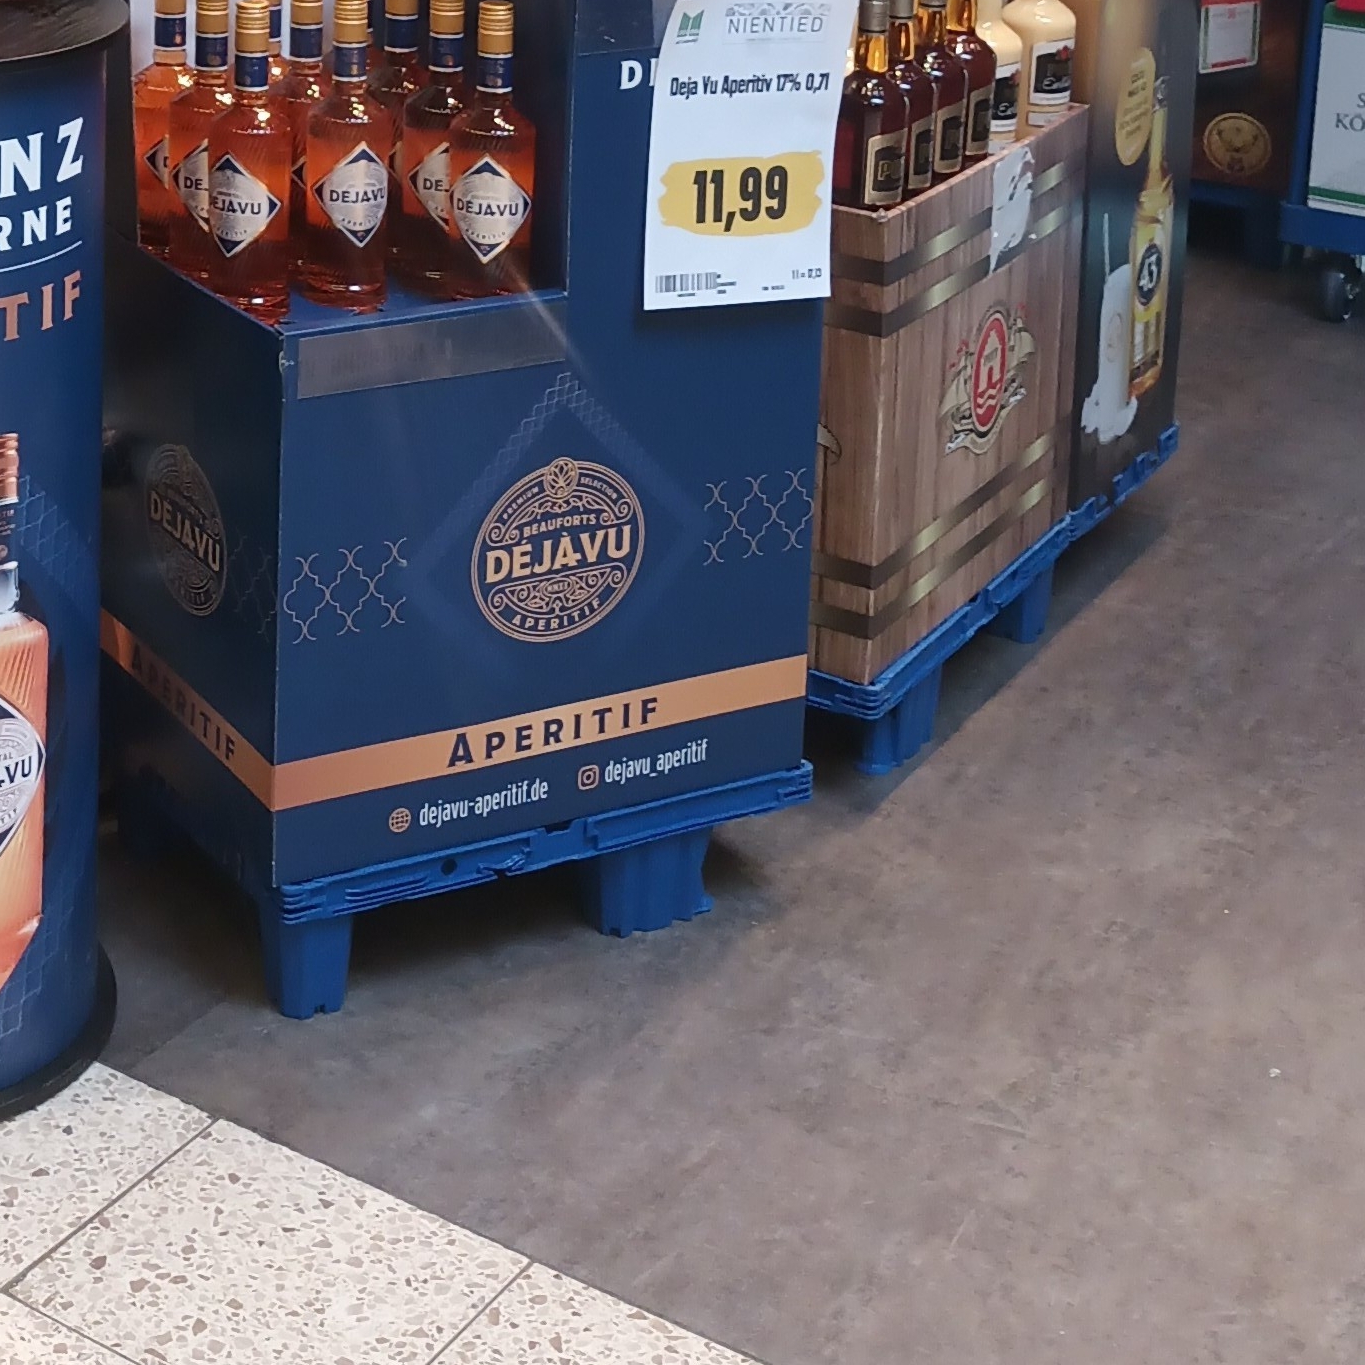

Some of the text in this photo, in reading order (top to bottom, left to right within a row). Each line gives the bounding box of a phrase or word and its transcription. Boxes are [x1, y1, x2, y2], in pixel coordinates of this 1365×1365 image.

[727, 15, 824, 35] NIENTIED
[670, 76, 697, 100] Deja
[703, 75, 718, 95] Vu
[721, 74, 771, 98] Aperitiv
[776, 72, 801, 93] 17%
[693, 165, 789, 233] 11,99
[502, 486, 540, 521] PREMIUM
[580, 476, 619, 501] SELECTION
[522, 514, 597, 538] BEAUFORTS
[511, 597, 602, 631] APERITIF
[446, 696, 658, 769] APERITIF
[604, 738, 709, 785] dejavu_aperitif
[419, 778, 549, 830] dejavu-aperitif.de
